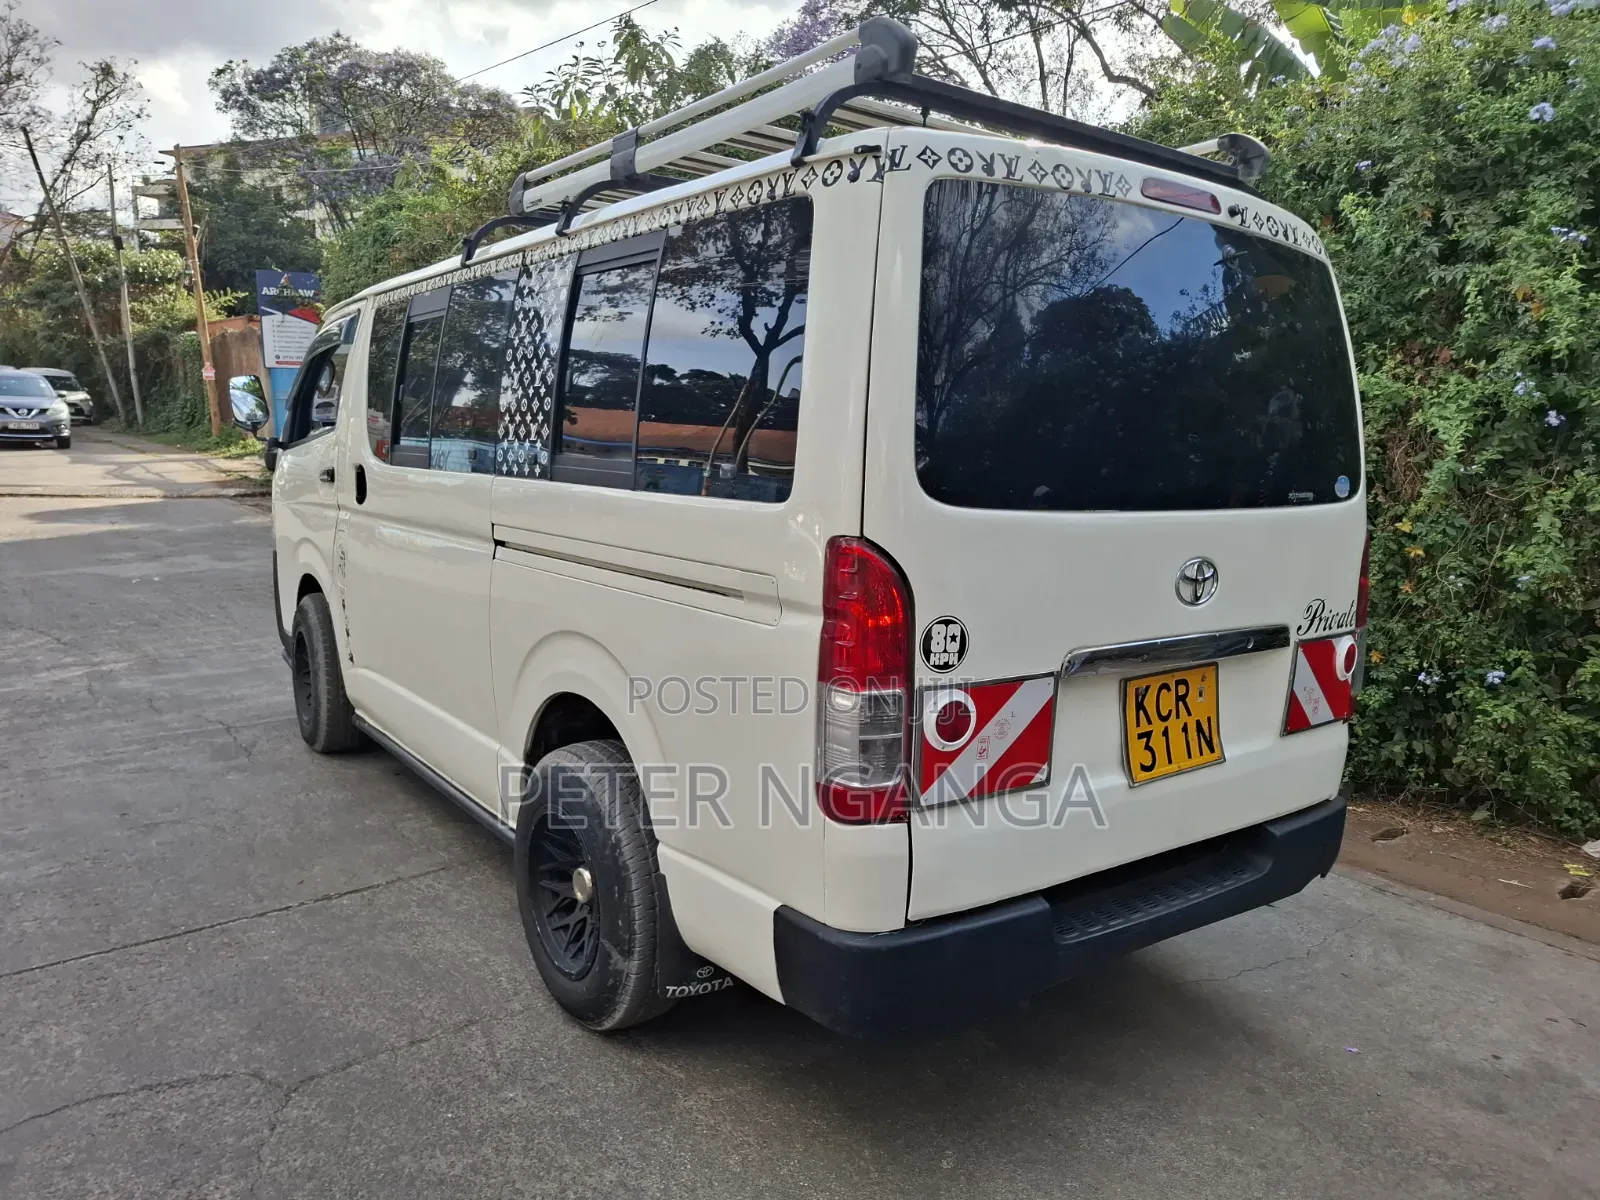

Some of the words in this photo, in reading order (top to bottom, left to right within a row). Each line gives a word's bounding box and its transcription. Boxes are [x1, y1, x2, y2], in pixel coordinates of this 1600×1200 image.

[929, 652, 959, 665] KPH
[1135, 678, 1193, 728] KCR
[1136, 715, 1216, 773] 311N
[665, 976, 735, 998] TOYOTA
